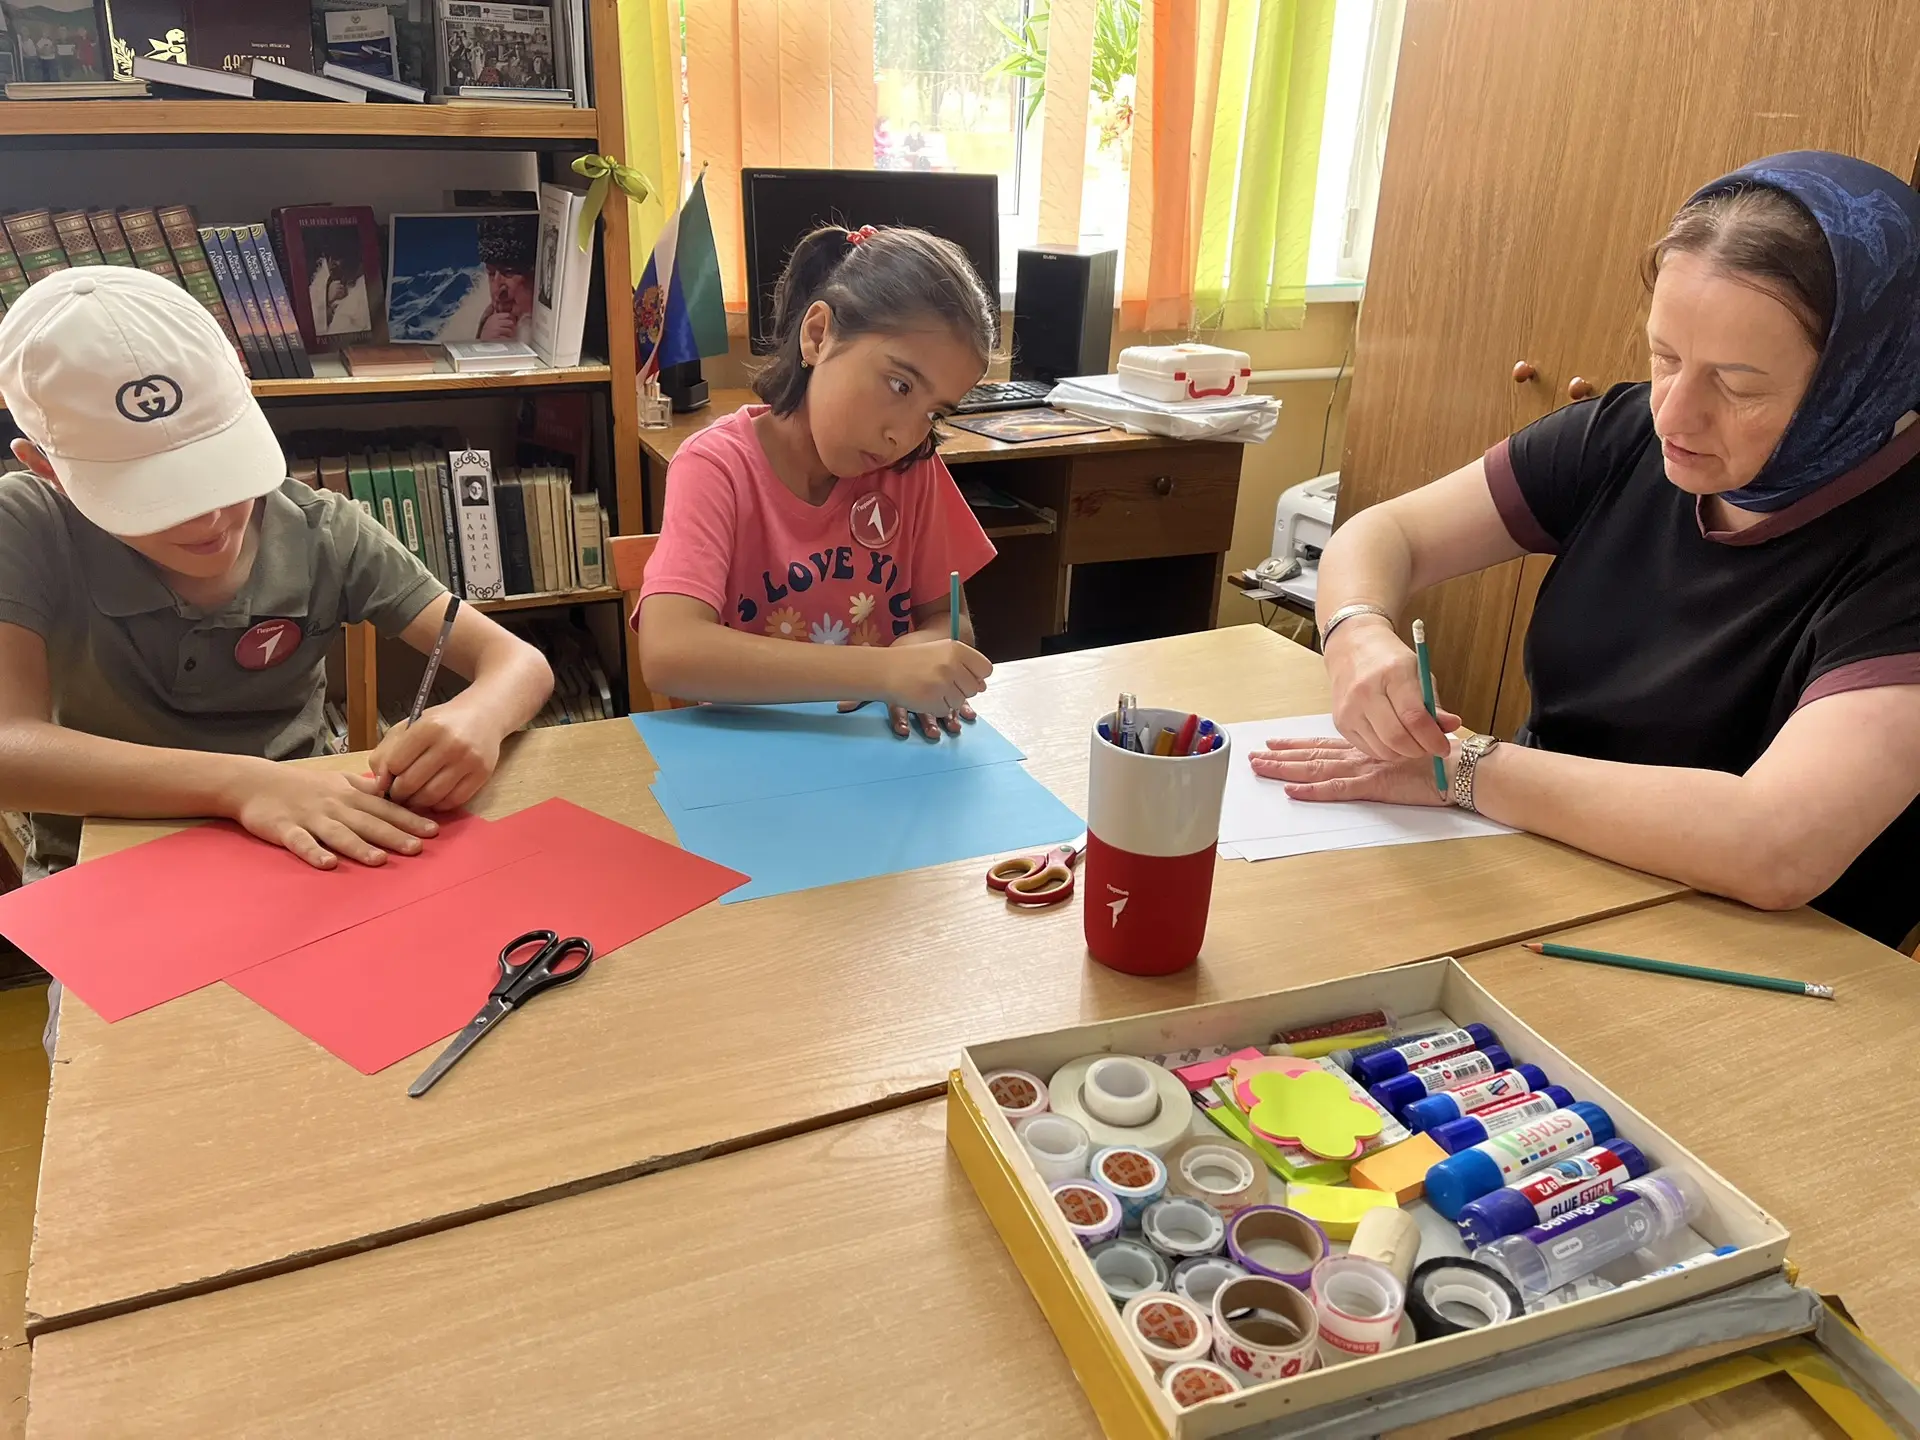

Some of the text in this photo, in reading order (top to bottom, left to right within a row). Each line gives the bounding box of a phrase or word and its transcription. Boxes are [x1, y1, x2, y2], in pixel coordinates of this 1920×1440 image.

[464, 512, 477, 573] ГАМЗАТ
[479, 513, 492, 570] ЦАДАСА
[762, 546, 854, 603] LOVE
[1517, 1115, 1572, 1148] STAFF
[1551, 1182, 1611, 1219] GLUE STICK
